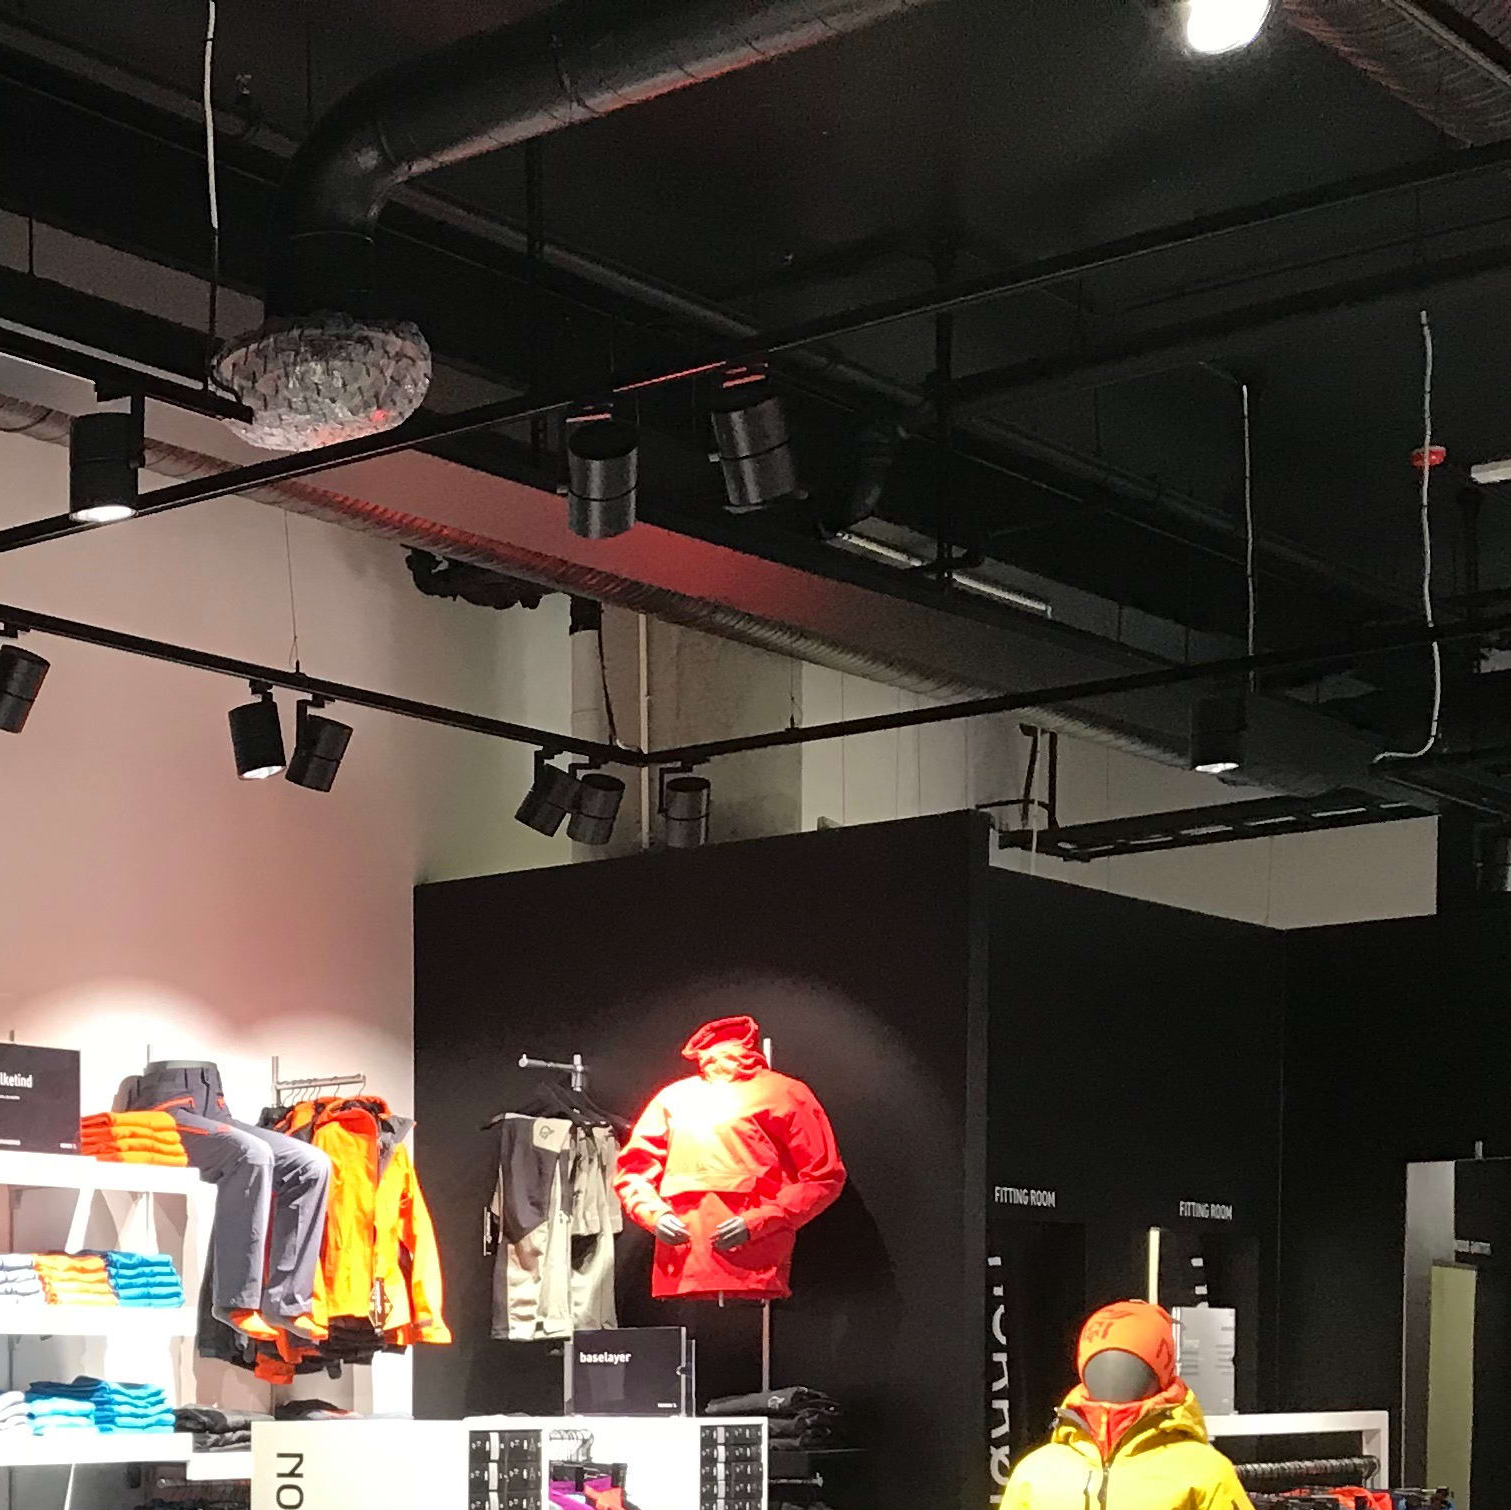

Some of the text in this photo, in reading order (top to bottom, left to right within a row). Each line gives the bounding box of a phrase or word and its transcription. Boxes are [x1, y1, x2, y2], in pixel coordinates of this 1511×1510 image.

[994, 1185, 1056, 1208] FITTING ROOM
[1179, 1200, 1233, 1220] FITTING ROOM
[579, 1351, 632, 1365] baselayer
